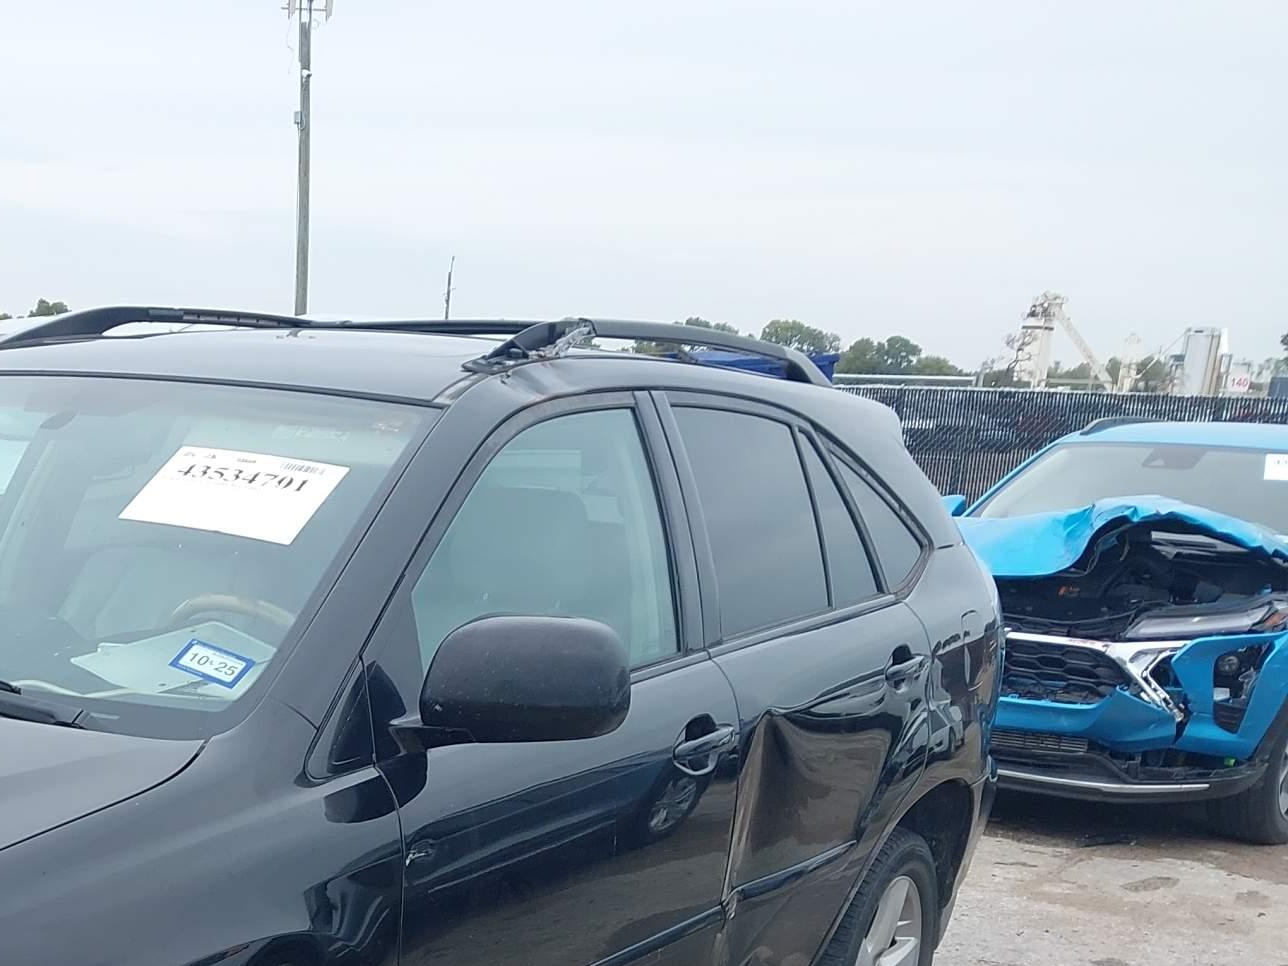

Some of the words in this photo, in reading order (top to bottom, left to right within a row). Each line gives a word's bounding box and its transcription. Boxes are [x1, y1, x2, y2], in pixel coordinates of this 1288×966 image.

[1231, 376, 1249, 388] 140
[177, 463, 310, 492] 43534701
[213, 661, 239, 677] 25
